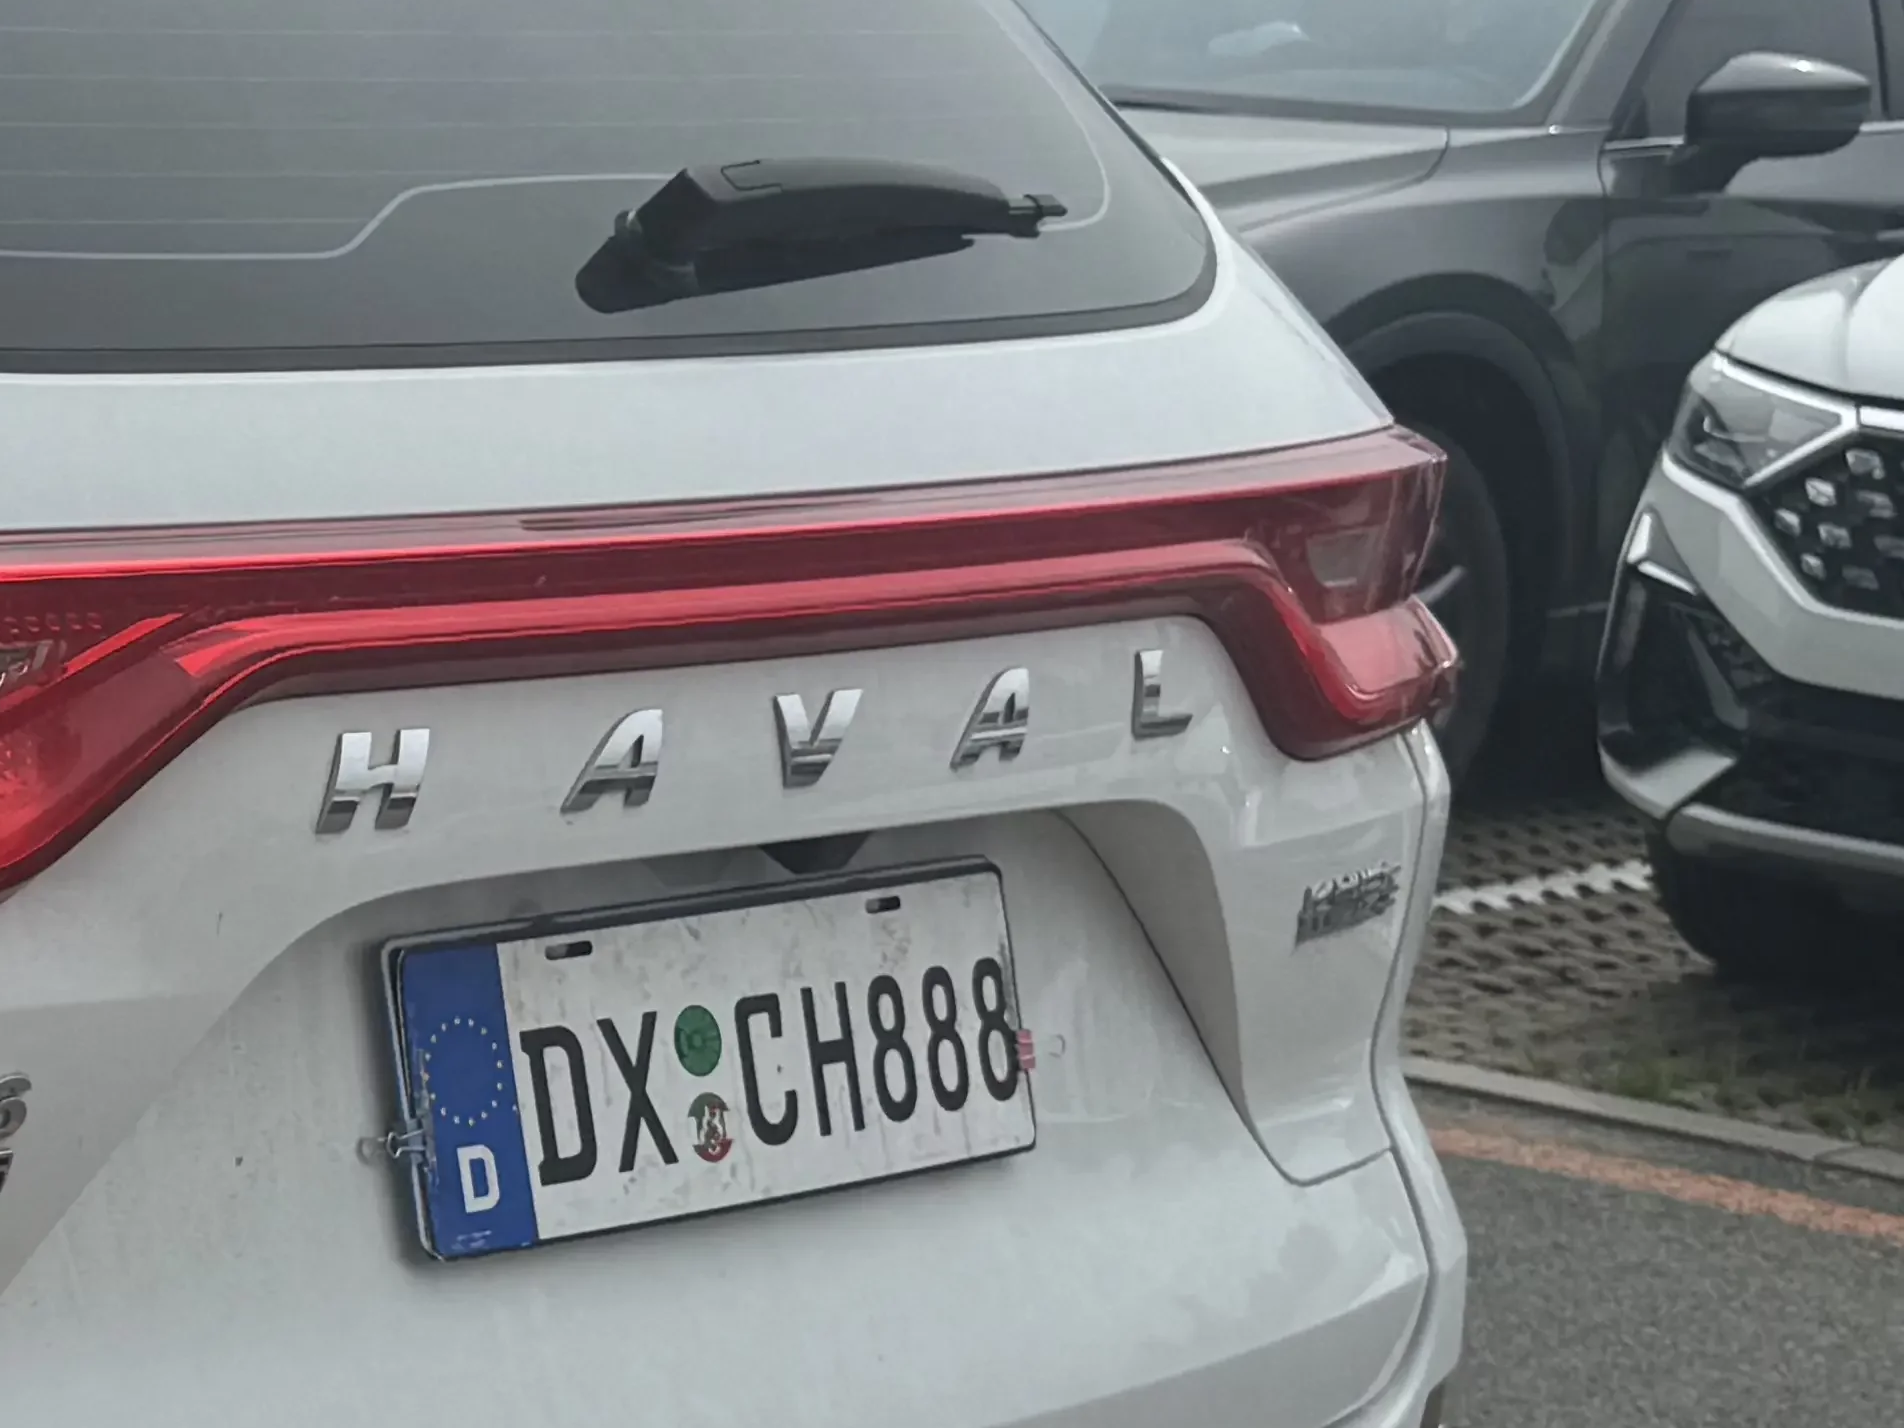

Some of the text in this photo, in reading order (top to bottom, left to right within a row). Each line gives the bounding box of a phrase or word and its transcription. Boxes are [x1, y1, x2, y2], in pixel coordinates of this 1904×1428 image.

[315, 648, 1193, 835] HAVAL
[518, 955, 1020, 1187] DX CH888
[456, 1143, 501, 1214] D
